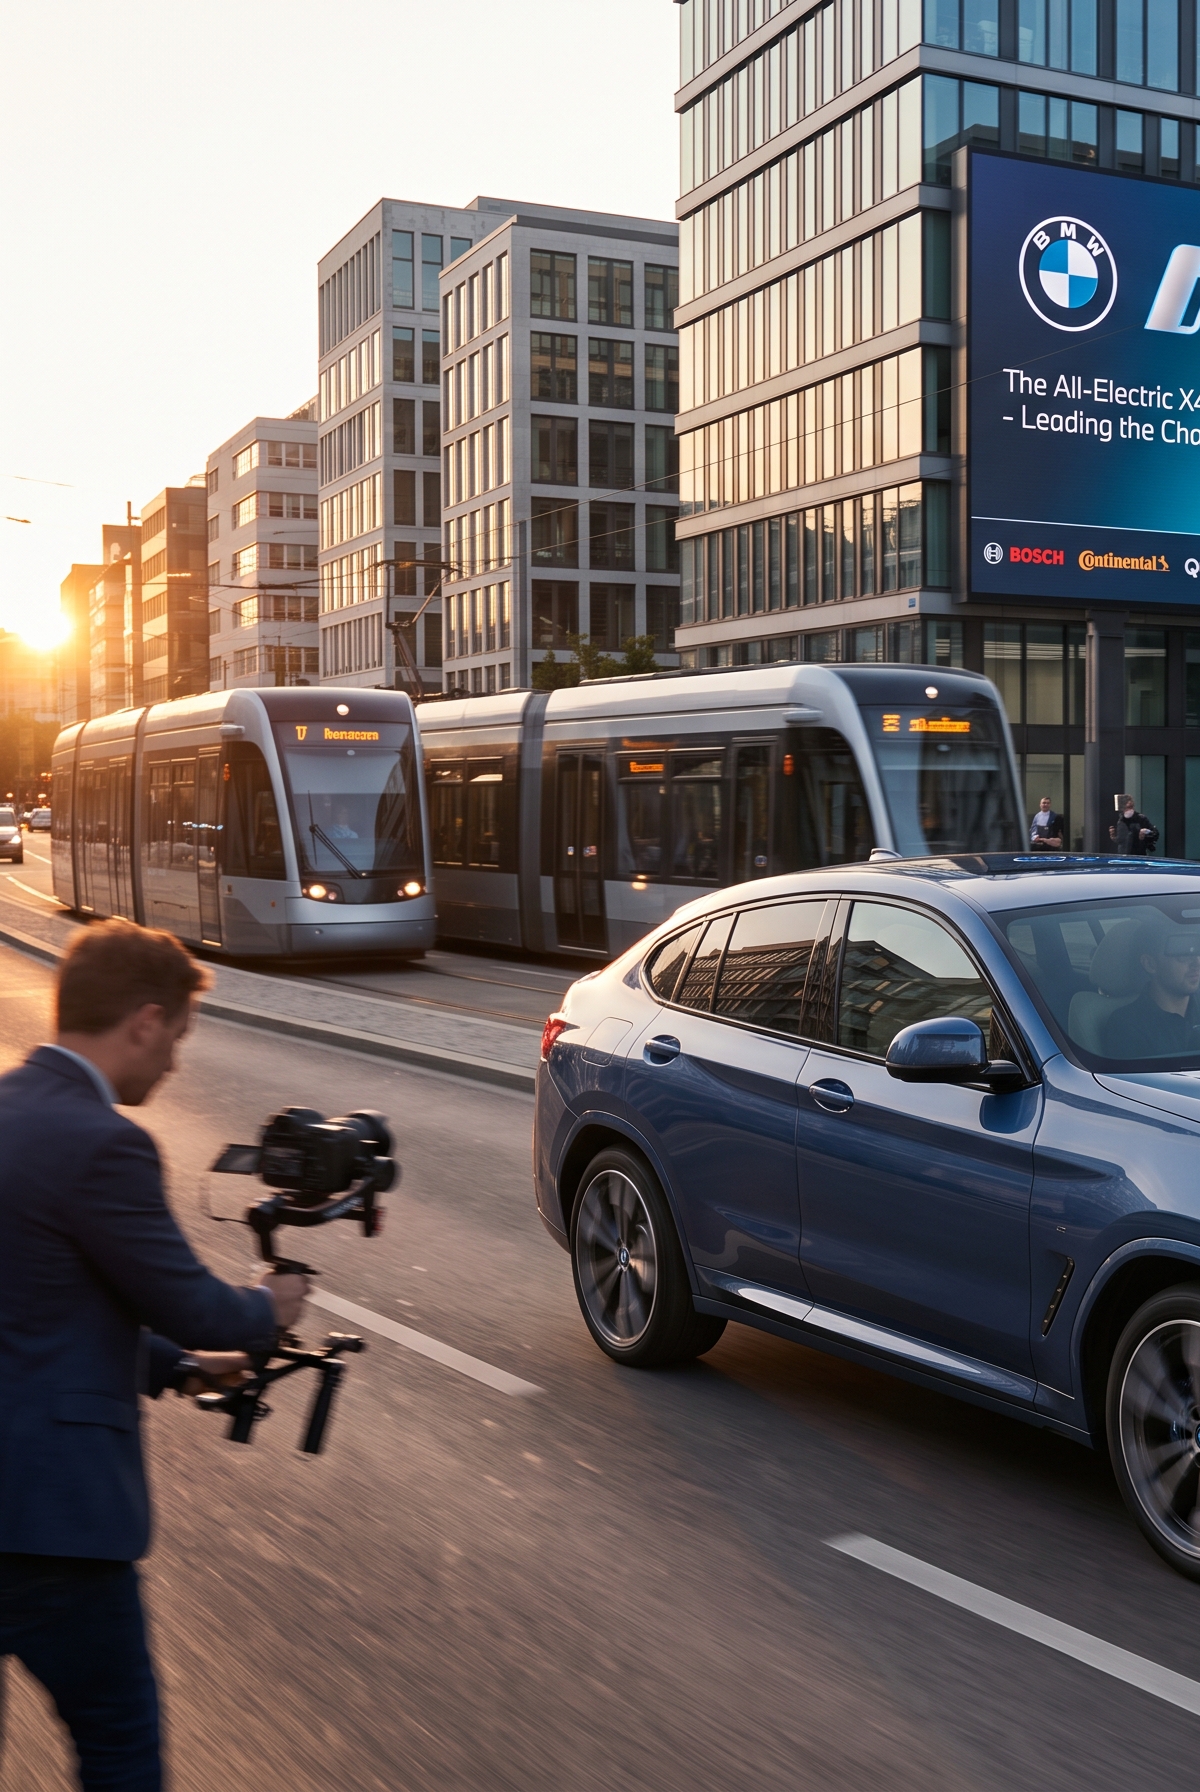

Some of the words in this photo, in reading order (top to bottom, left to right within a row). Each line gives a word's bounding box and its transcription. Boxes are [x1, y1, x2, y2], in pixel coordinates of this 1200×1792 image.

[1002, 368, 1047, 396] The
[1053, 374, 1174, 410] All-Electric
[1021, 404, 1113, 442] Leading
[1119, 415, 1154, 440] the
[1009, 546, 1065, 565] BOSCH
[1077, 550, 1158, 571] Continental
